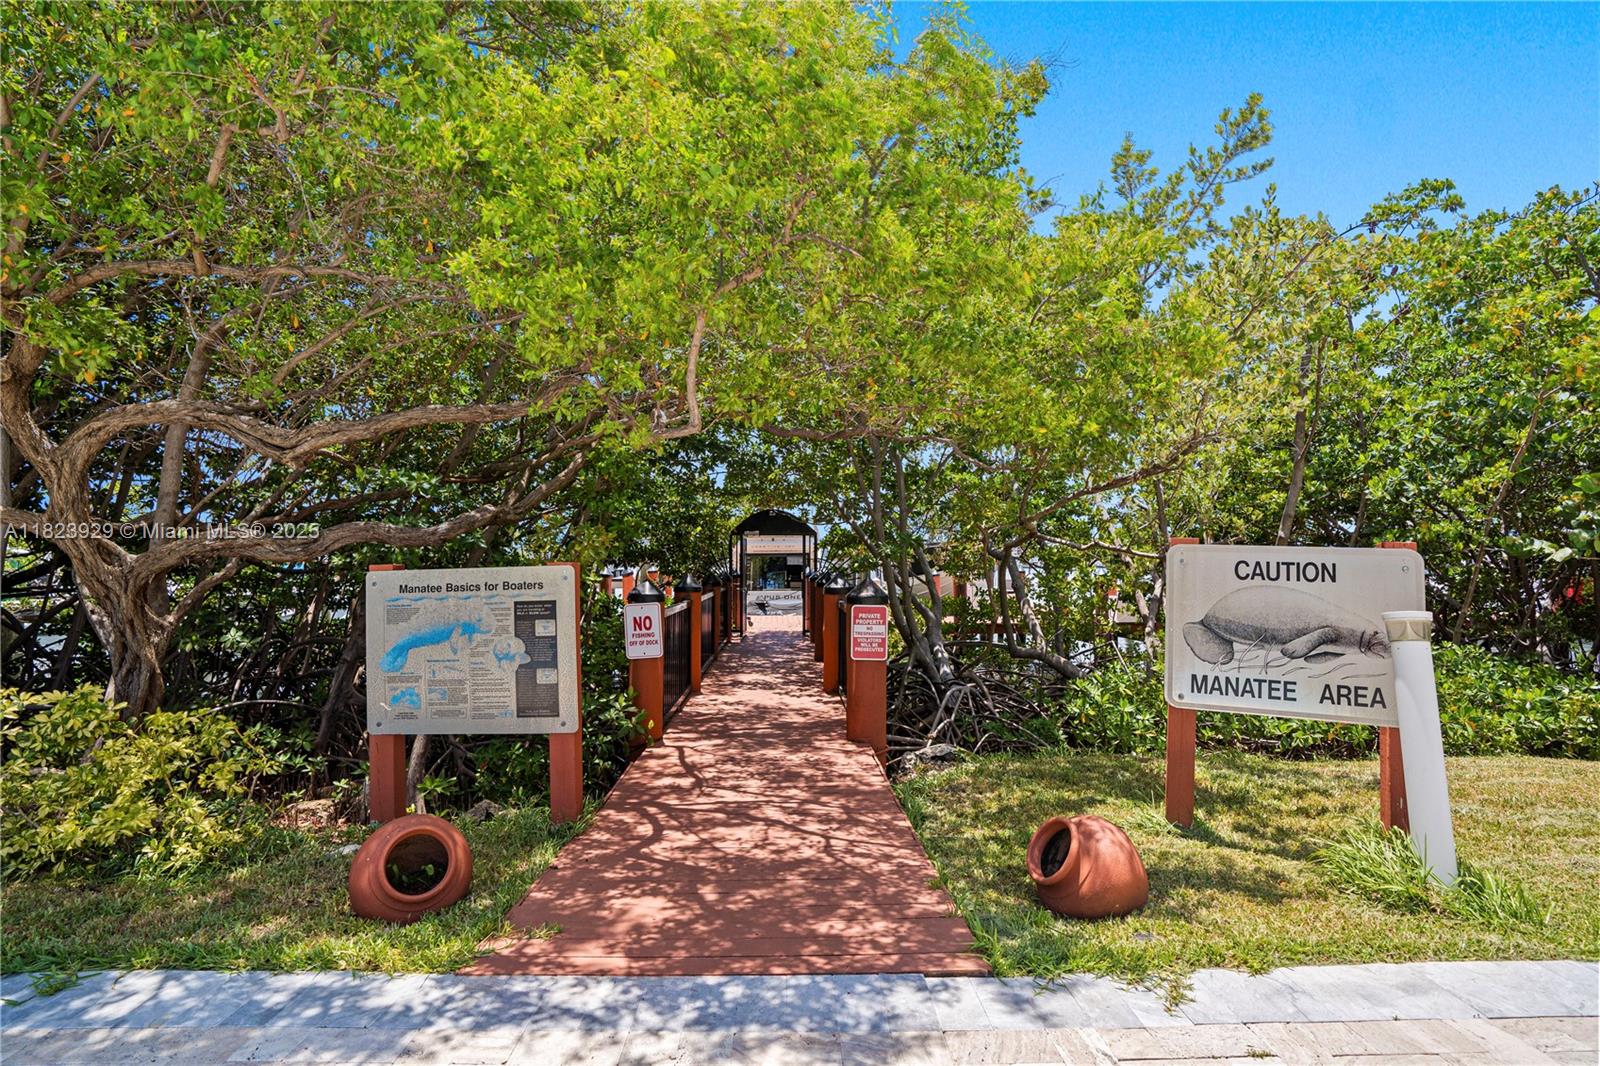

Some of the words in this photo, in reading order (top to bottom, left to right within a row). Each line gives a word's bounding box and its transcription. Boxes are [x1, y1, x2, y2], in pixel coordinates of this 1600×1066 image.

[1234, 560, 1337, 583] CAUTION
[399, 584, 443, 594] Manatee
[445, 583, 481, 593] Basics
[484, 582, 499, 592] for
[502, 581, 544, 591] Boaters
[633, 616, 652, 631] NO
[1190, 674, 1297, 702] MANATEE
[1319, 684, 1387, 709] AREA
